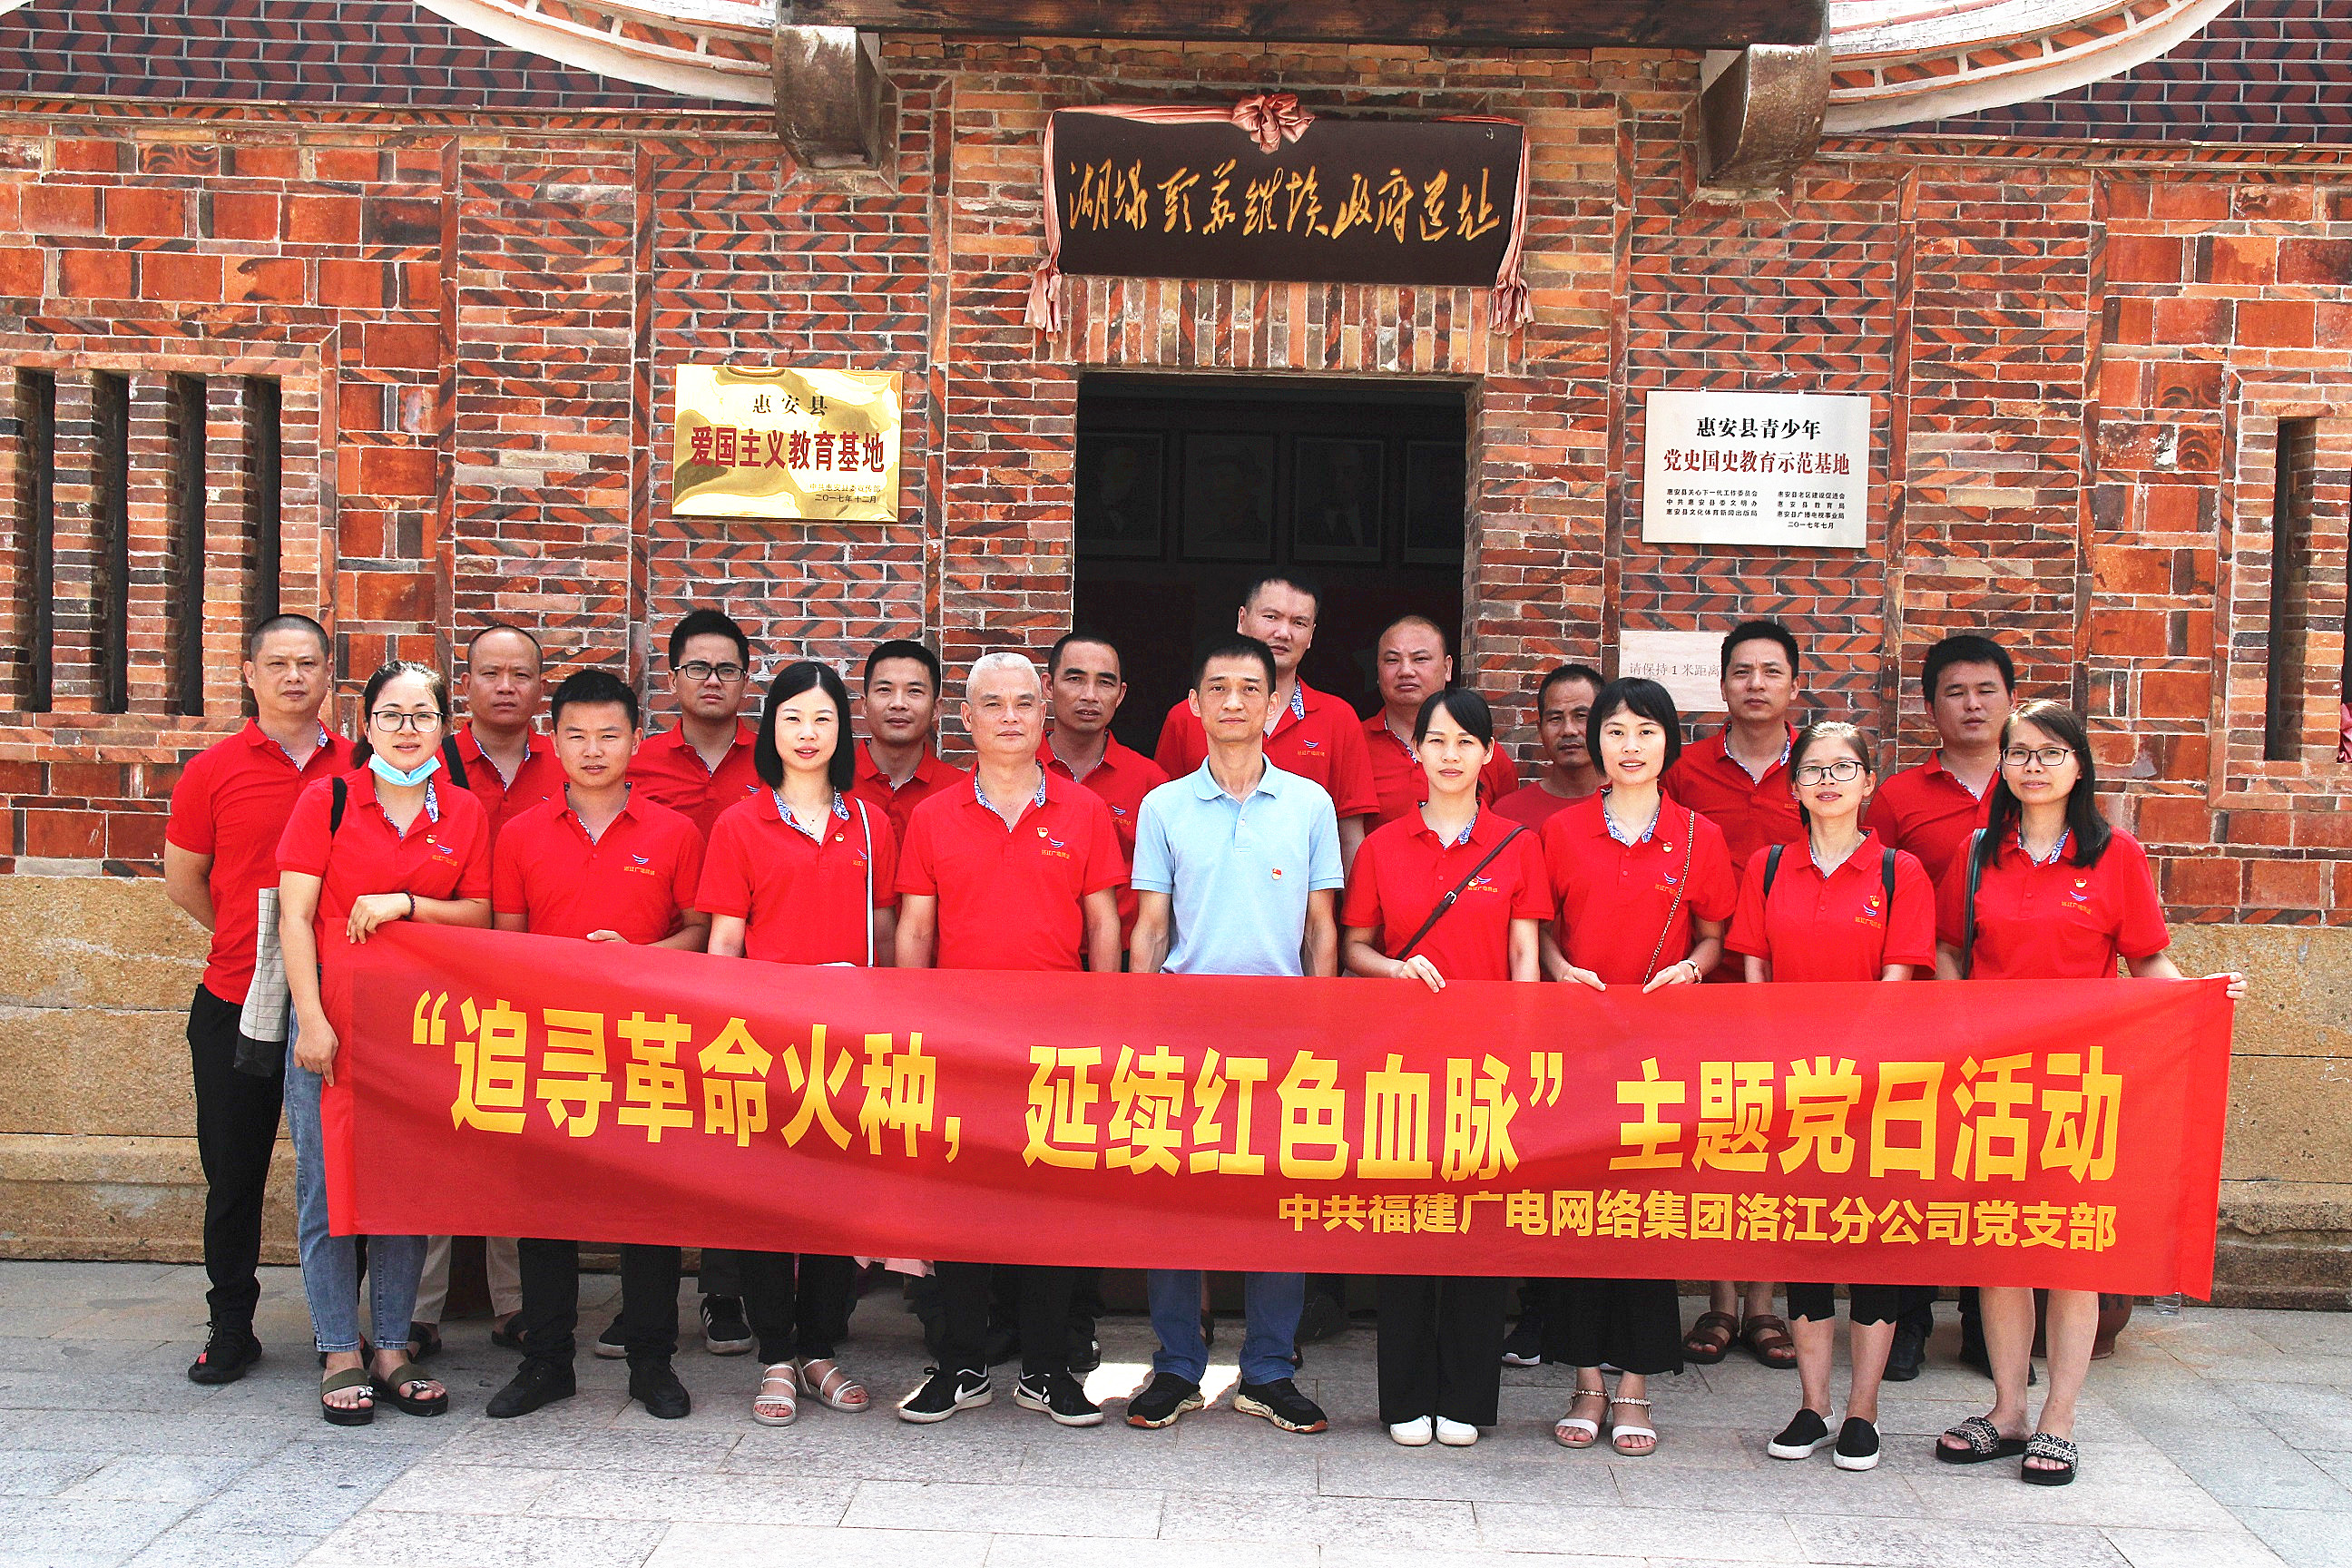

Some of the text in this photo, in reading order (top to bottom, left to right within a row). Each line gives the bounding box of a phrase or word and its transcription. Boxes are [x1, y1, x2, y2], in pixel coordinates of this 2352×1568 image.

[752, 394, 828, 416] 惠安县
[1696, 416, 1821, 440] 惠安县青少年
[691, 426, 885, 473] 爱国主义教育基地
[1663, 448, 1850, 475] 党史国史教育示范基地
[1667, 488, 1758, 496] 惠安县关心下一代工作委员会
[1778, 491, 1846, 499] 惠安县老区建设促进会
[1609, 1045, 2122, 1183] 主题党日活动
[1279, 1188, 2117, 1252] 中共福建广电网络集团洛江分公司党支部
